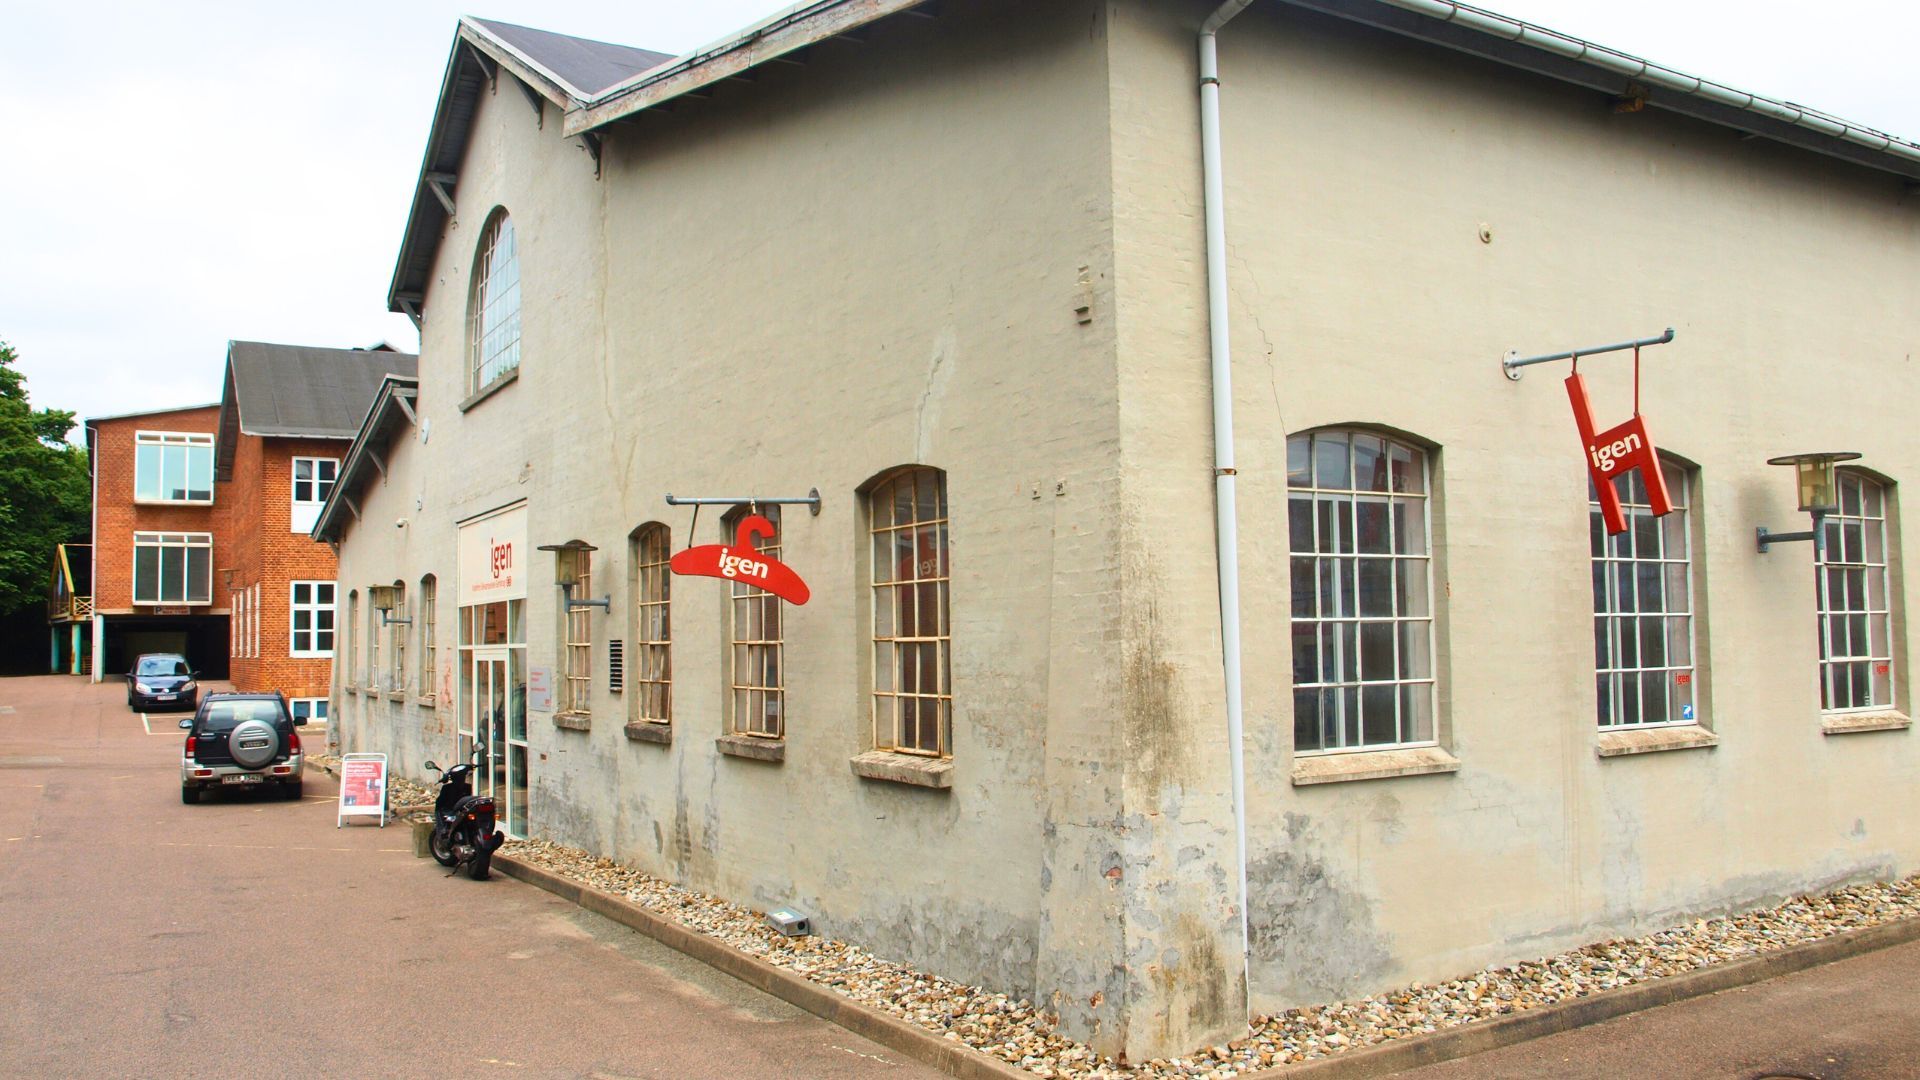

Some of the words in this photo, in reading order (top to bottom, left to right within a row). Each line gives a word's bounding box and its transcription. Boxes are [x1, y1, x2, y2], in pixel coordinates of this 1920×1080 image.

[1590, 433, 1641, 472] igen
[491, 537, 512, 579] igen
[718, 547, 768, 579] igen
[1675, 673, 1690, 685] igen
